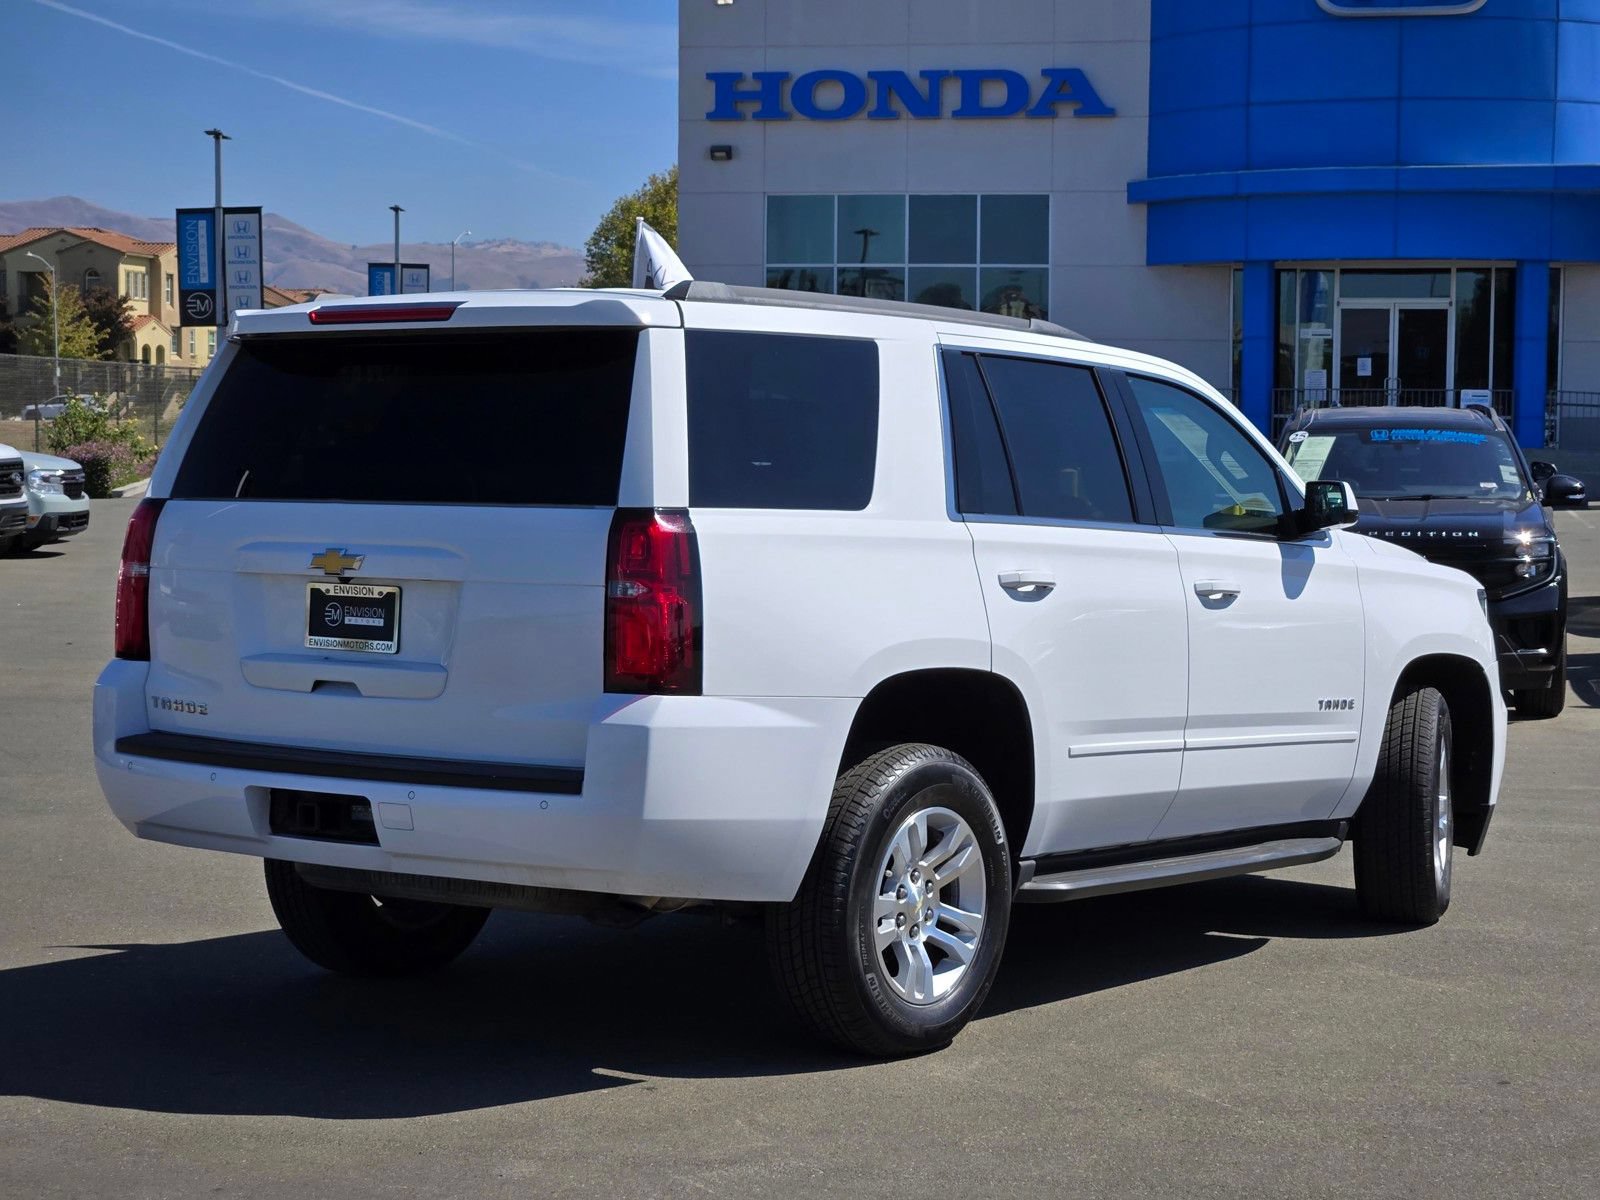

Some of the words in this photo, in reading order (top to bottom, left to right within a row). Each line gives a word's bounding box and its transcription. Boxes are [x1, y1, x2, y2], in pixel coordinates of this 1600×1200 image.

[705, 67, 1116, 121] HONDA
[185, 219, 200, 284] ENVISION
[333, 585, 375, 596] ENVISION
[344, 605, 385, 618] ENVISION
[308, 638, 393, 652] ENVISIONMOTORS.COM
[151, 695, 208, 715] TAHOE
[1318, 698, 1355, 711] TAHOE
